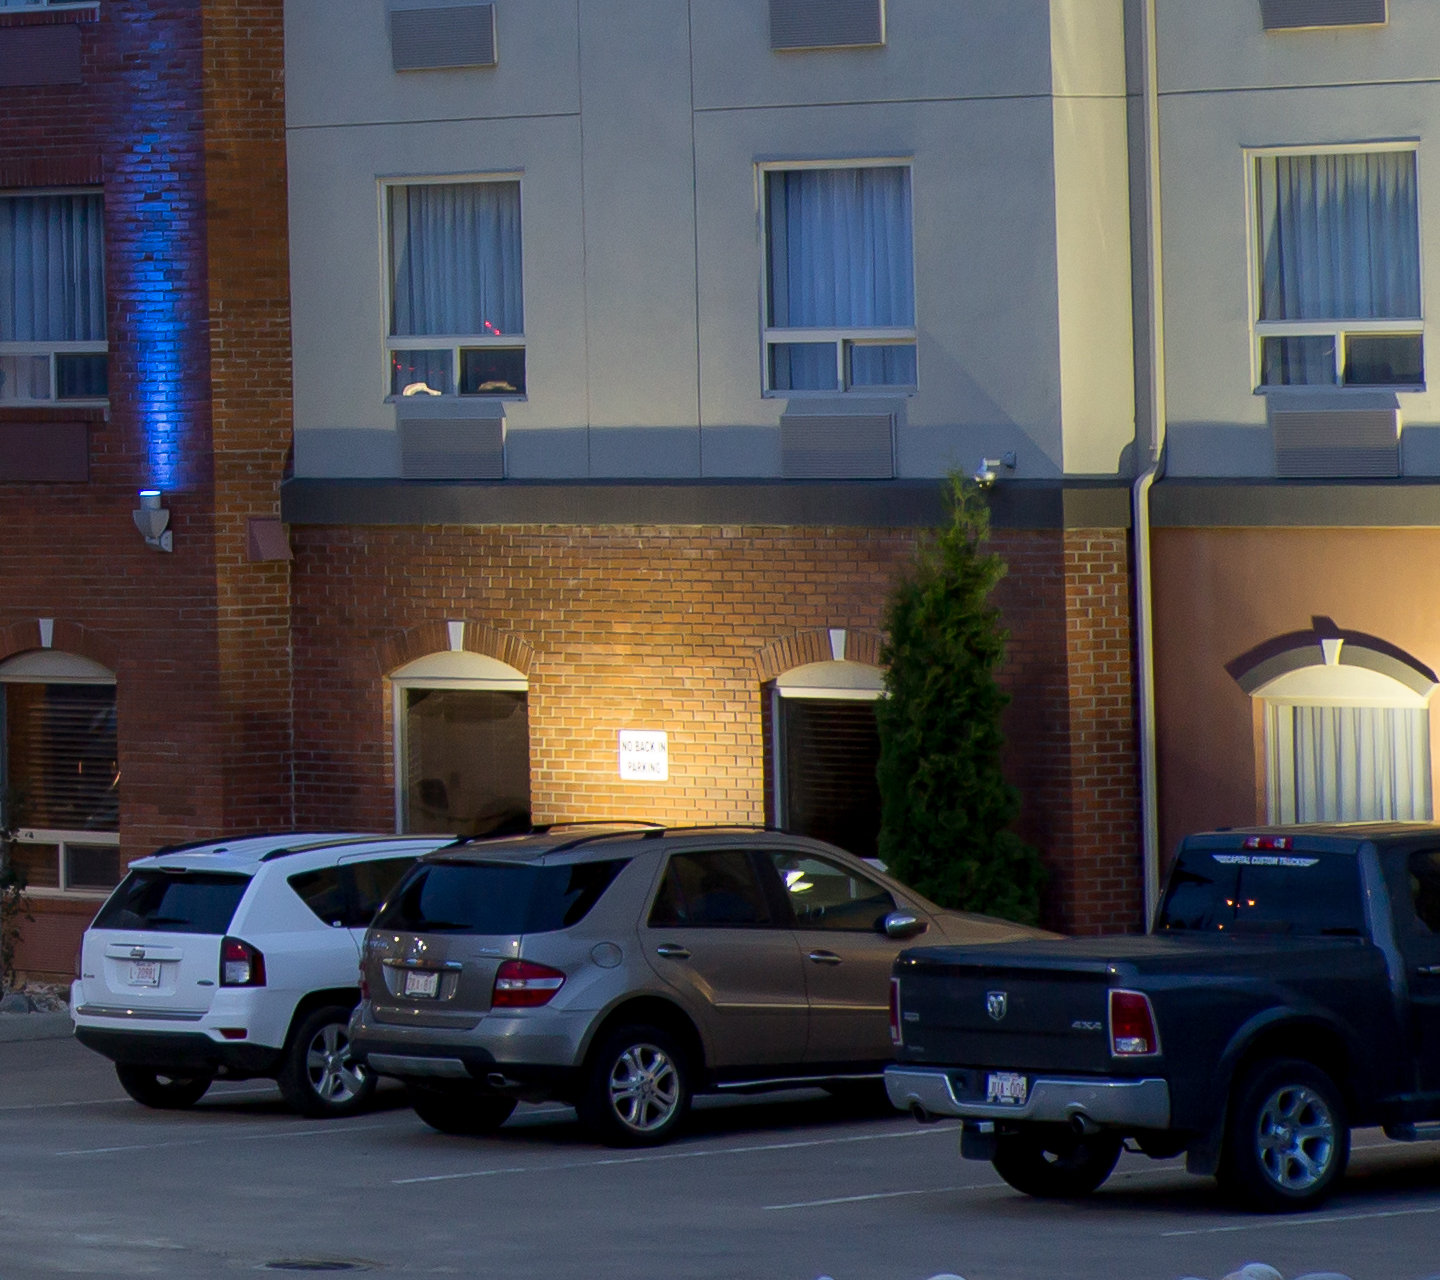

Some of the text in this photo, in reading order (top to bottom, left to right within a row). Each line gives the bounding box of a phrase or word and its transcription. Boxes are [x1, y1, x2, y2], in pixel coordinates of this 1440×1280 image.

[622, 740, 666, 752] NO BACK IN
[628, 760, 661, 774] PARKING
